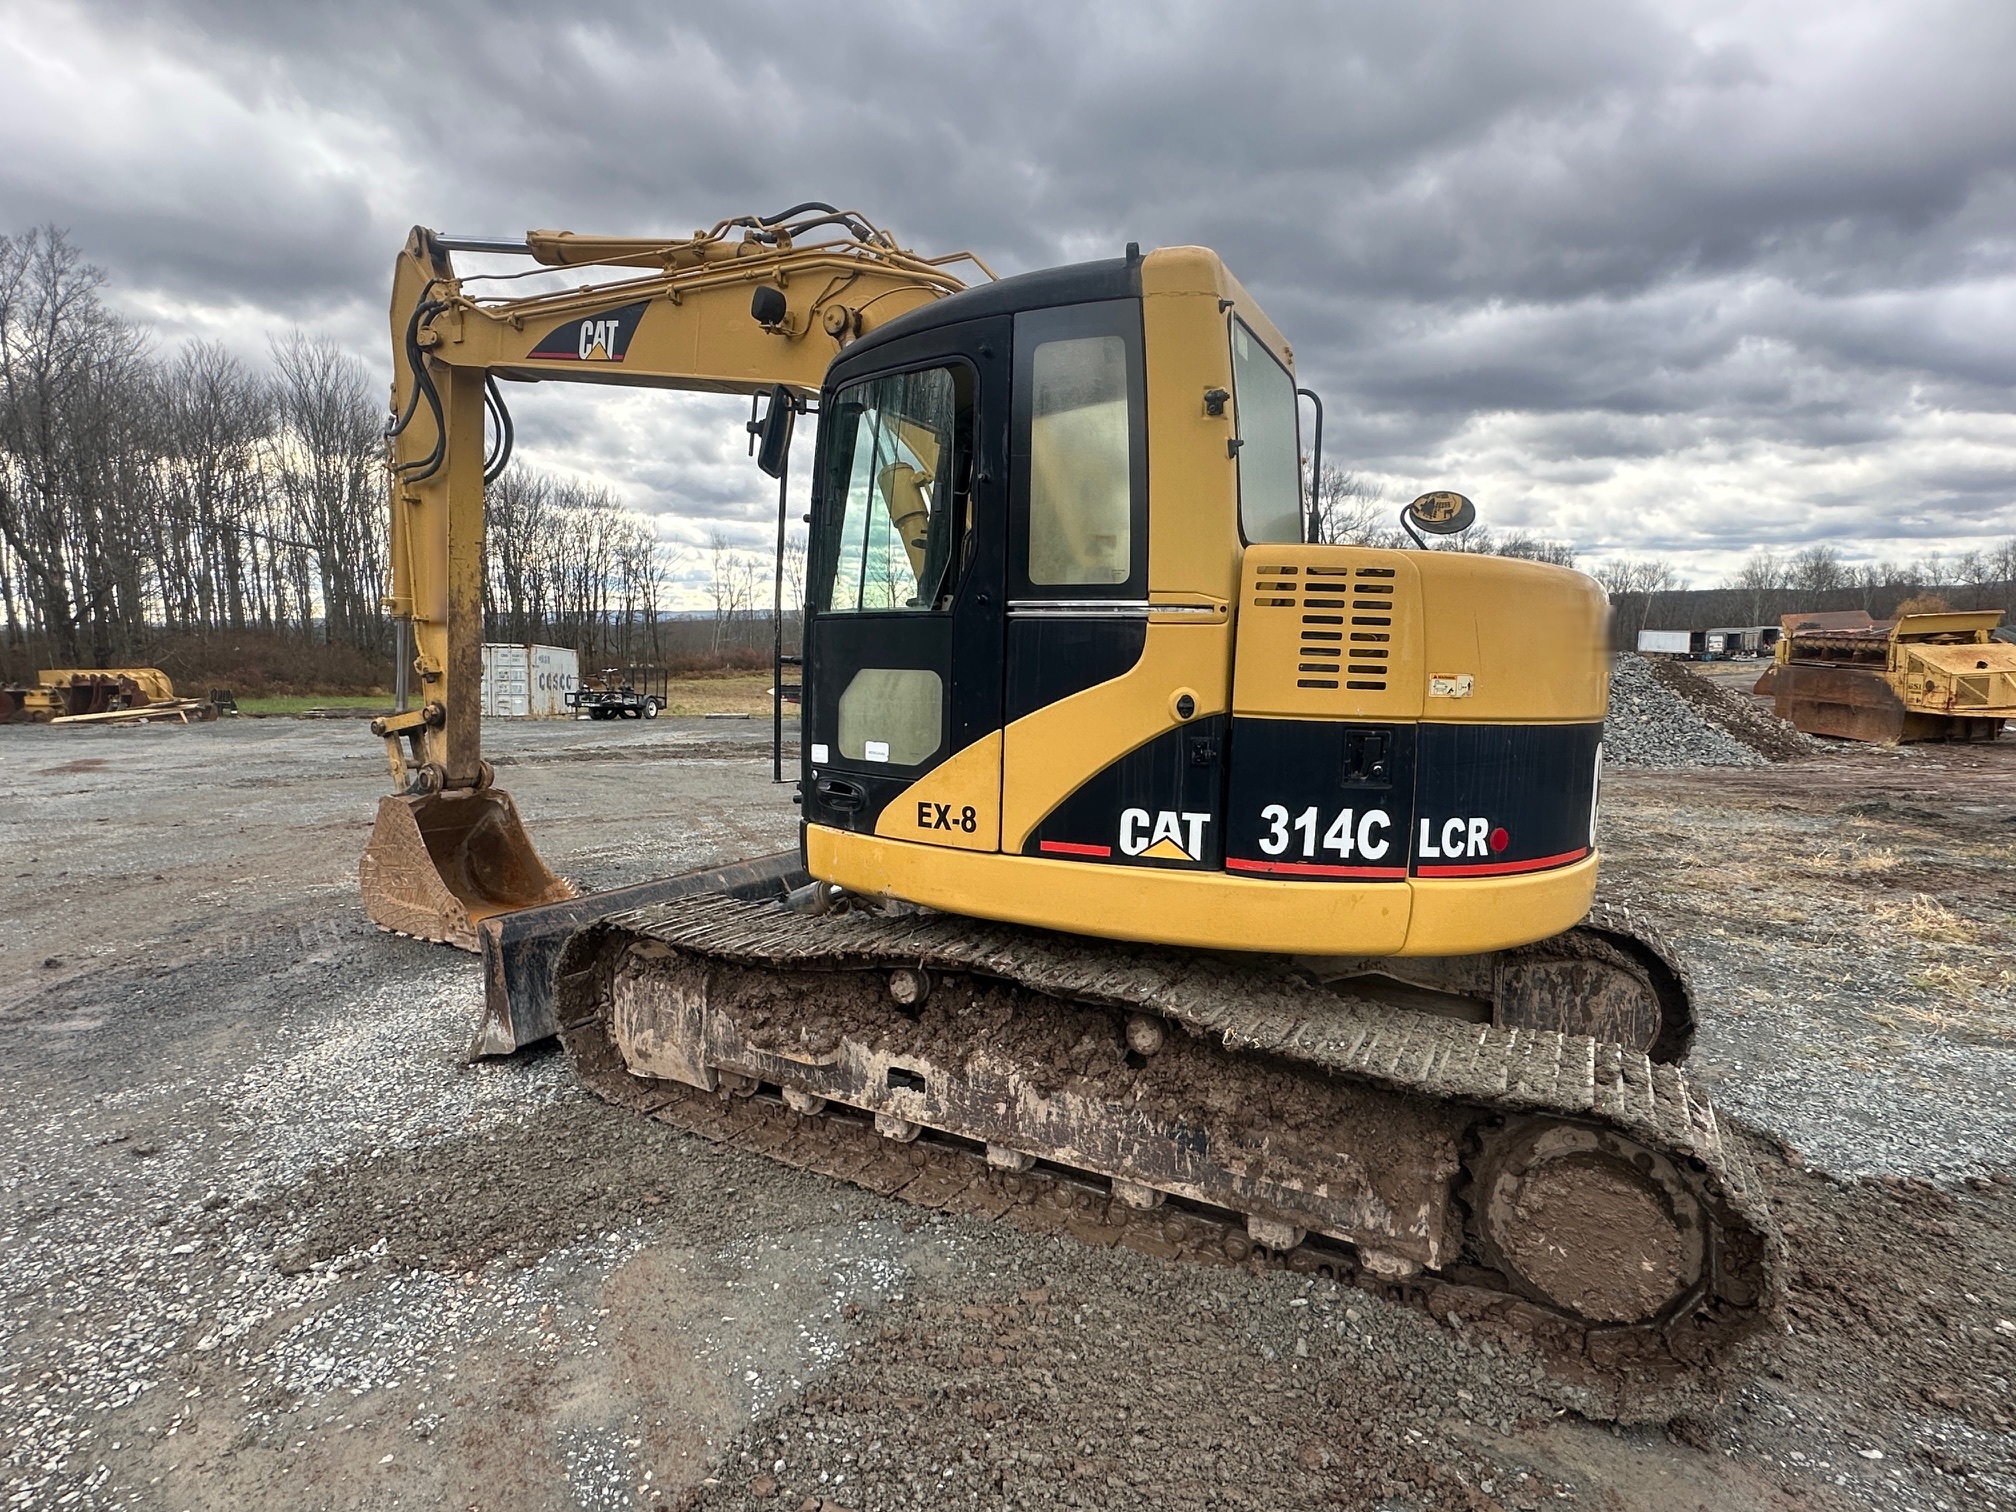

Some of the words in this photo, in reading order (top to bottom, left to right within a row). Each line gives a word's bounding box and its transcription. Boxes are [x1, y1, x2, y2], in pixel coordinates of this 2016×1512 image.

[579, 320, 619, 360] CAT
[917, 802, 977, 833] EX-8
[1119, 808, 1211, 861] CAT
[1258, 804, 1391, 860] 314C
[1418, 817, 1489, 857] LCR
